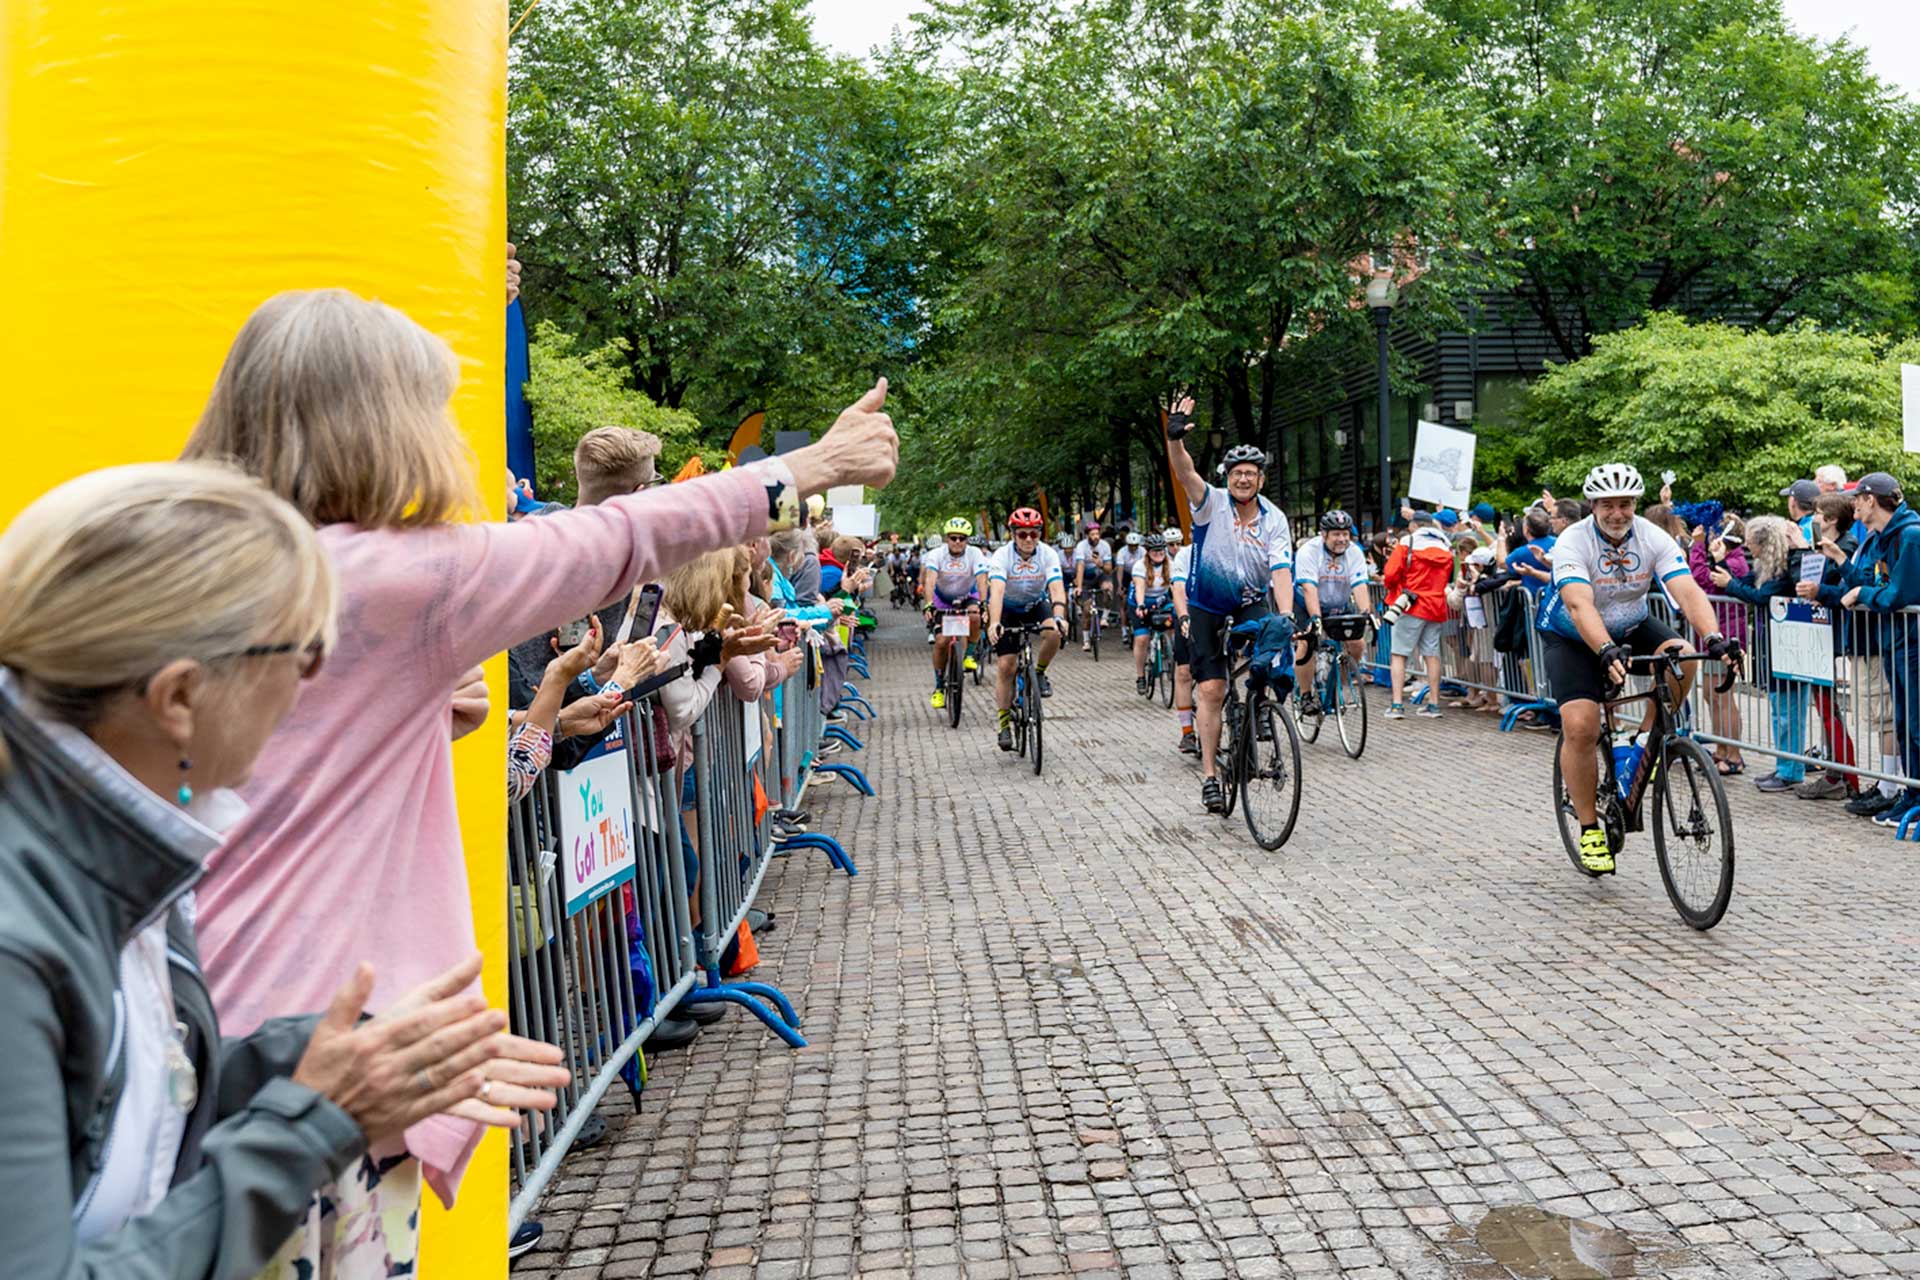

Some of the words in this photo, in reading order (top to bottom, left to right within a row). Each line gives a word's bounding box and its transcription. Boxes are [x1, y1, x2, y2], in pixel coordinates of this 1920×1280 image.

[579, 777, 603, 822] You
[574, 831, 596, 884] Got
[599, 807, 630, 867] This!
